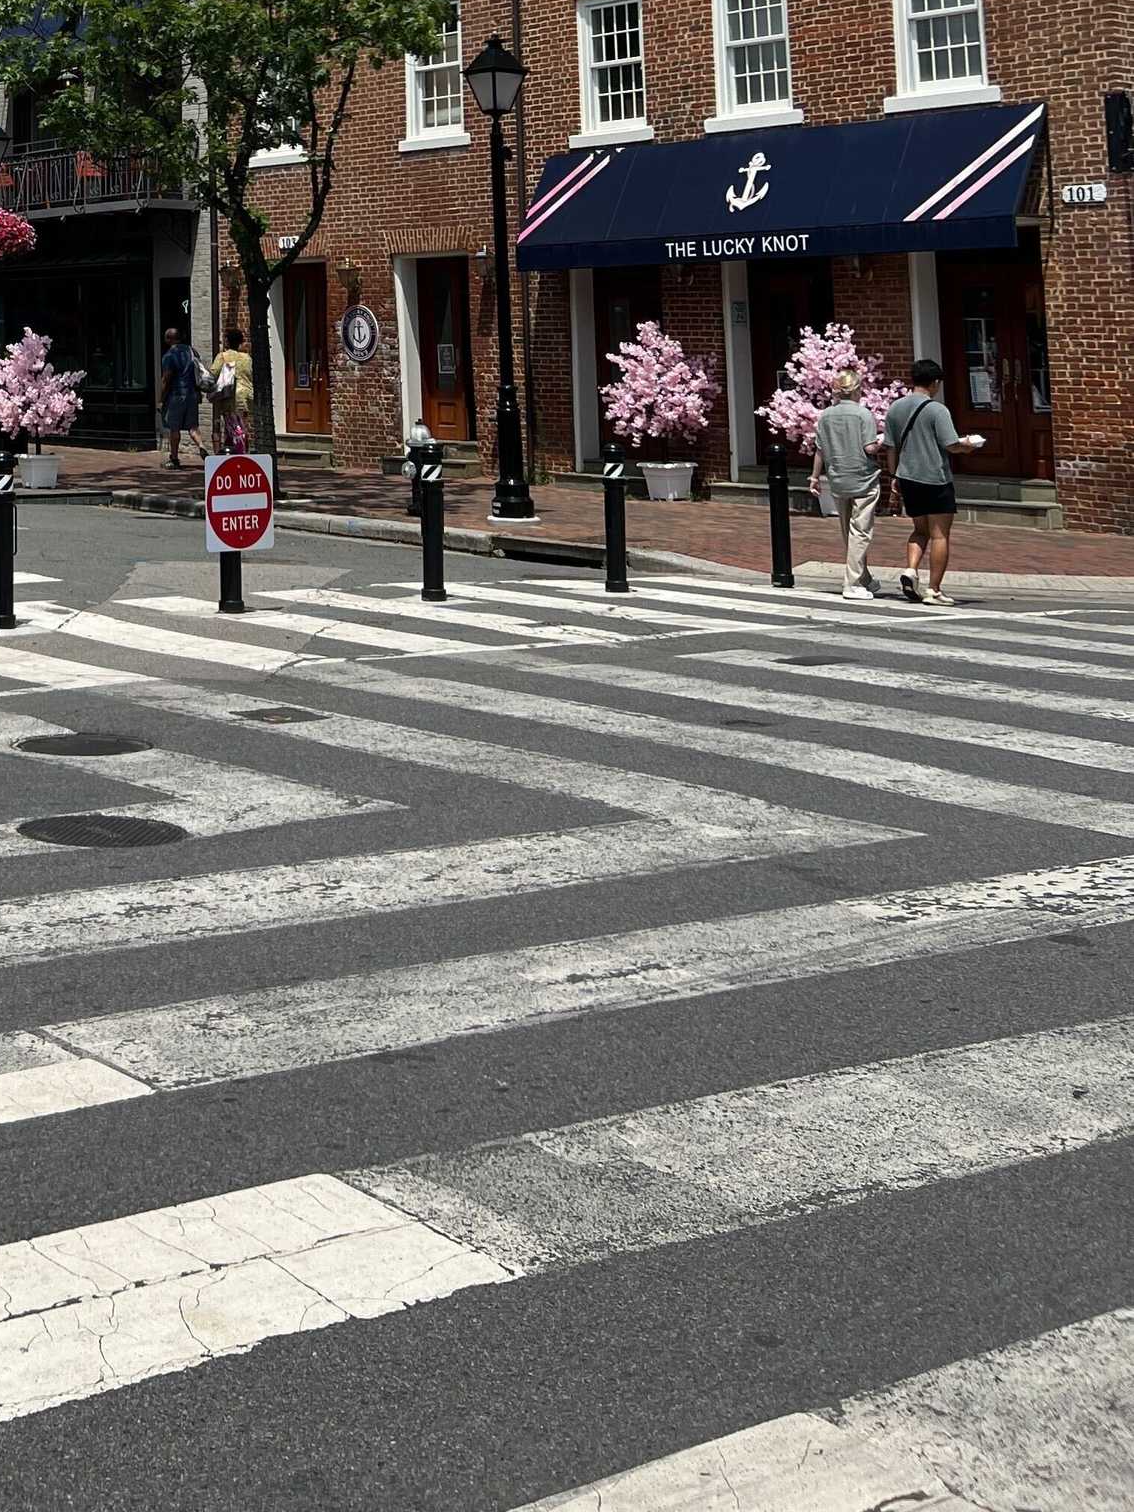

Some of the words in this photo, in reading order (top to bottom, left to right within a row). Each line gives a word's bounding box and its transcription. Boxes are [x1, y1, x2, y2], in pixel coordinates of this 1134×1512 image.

[1067, 186, 1095, 201] 101
[665, 242, 697, 258] THE
[702, 237, 755, 256] LUCKY
[762, 234, 809, 253] KNOT
[216, 475, 232, 490] DO
[239, 473, 262, 488] NOT
[222, 514, 259, 532] ENTER
